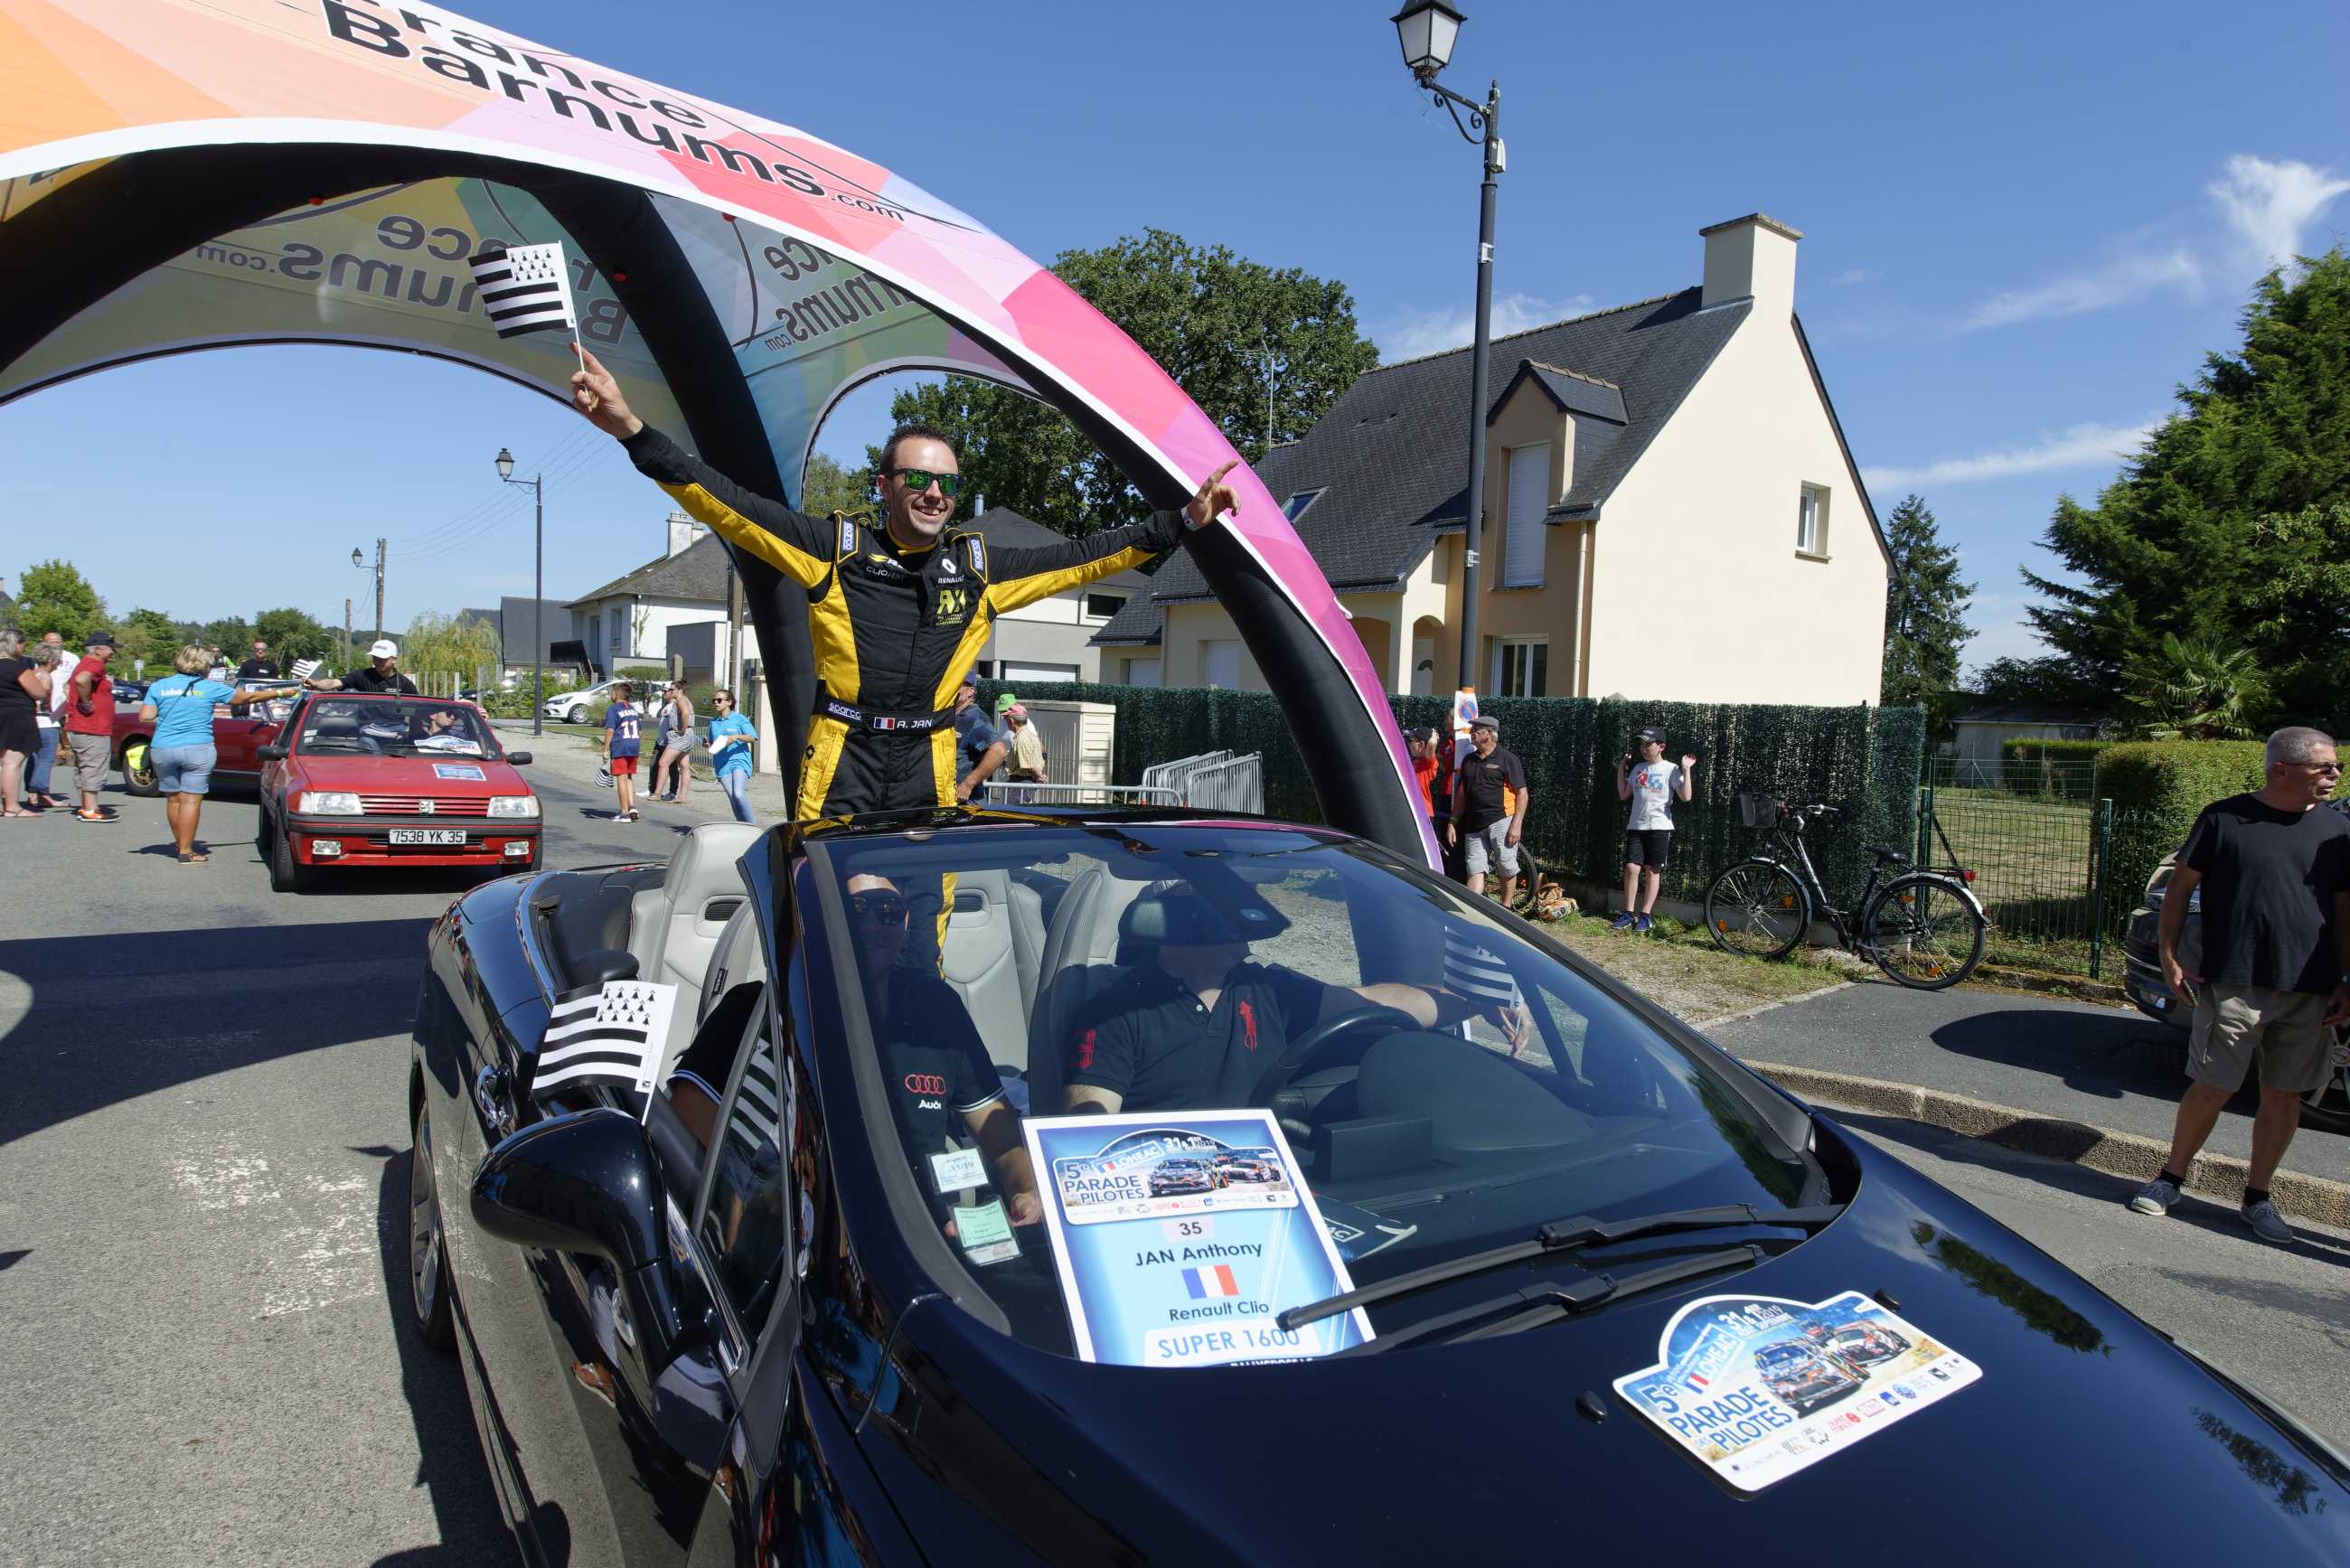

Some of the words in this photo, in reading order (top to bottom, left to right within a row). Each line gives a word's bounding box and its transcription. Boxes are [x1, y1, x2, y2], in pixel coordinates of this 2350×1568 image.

[360, 0, 708, 128] rance
[828, 702, 861, 720] sparco
[621, 720, 639, 738] 11
[911, 719, 933, 728] JAN
[392, 830, 424, 843] 7538
[426, 831, 446, 842] YK
[447, 831, 463, 843] 35
[917, 1099, 942, 1110] Audi
[1064, 1176, 1141, 1193] PARADE
[1081, 1188, 1144, 1204] PILOTES
[1179, 1222, 1202, 1235] 35
[1135, 1249, 1175, 1266] JAN
[1182, 1244, 1263, 1261] Anthony
[1170, 1301, 1233, 1321] Renault
[1237, 1300, 1270, 1314] Clio
[1158, 1331, 1236, 1357] SUPER
[1244, 1329, 1300, 1348] 1600
[1668, 1385, 1770, 1438] PARADE
[1708, 1406, 1793, 1451] PILOTES
